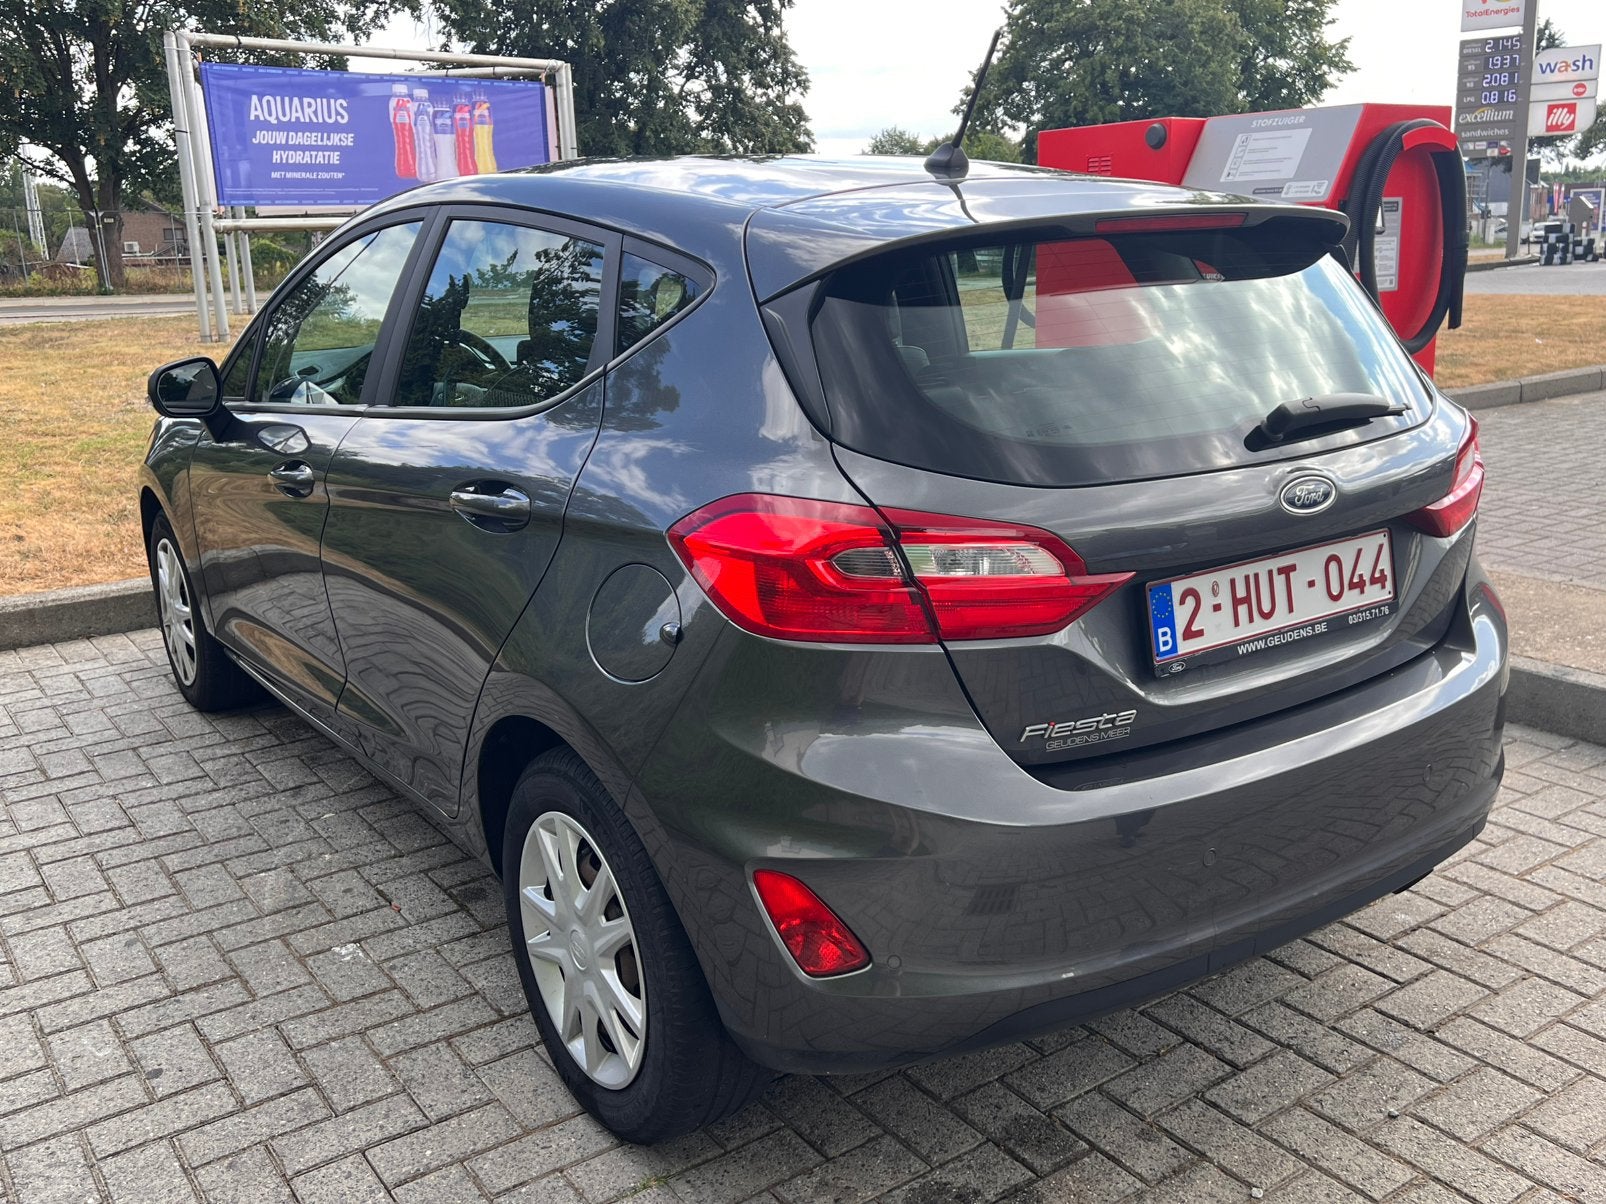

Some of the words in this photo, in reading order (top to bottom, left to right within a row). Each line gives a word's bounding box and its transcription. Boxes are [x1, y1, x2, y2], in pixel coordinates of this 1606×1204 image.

[1465, 6, 1520, 18] TotalEnergies
[1485, 37, 1520, 53] 2.145
[1488, 54, 1519, 69] 1.937
[1539, 54, 1593, 74] wash
[1482, 72, 1518, 87] 2.081
[1481, 89, 1516, 104] 0.816
[249, 94, 349, 124] AQUARIUS
[1459, 109, 1513, 123] excellium
[1250, 115, 1307, 128] STOFZUIGER
[1547, 107, 1575, 129] illy
[252, 130, 287, 145] JOUW
[288, 131, 355, 146] DAGELIJKSE
[1461, 127, 1509, 138] sandwiches
[272, 150, 341, 164] HYDRATATIE
[271, 171, 285, 179] MET
[285, 171, 317, 179] MINERALE
[1294, 484, 1325, 507] Ford
[1348, 606, 1390, 625] 03/315.71.76
[1157, 627, 1173, 652] B
[1237, 622, 1329, 656] WWW.GEUDENS.BE
[1020, 709, 1137, 742] Fiesta
[1045, 733, 1100, 750] GEUDENS
[1100, 726, 1131, 741] MEER
